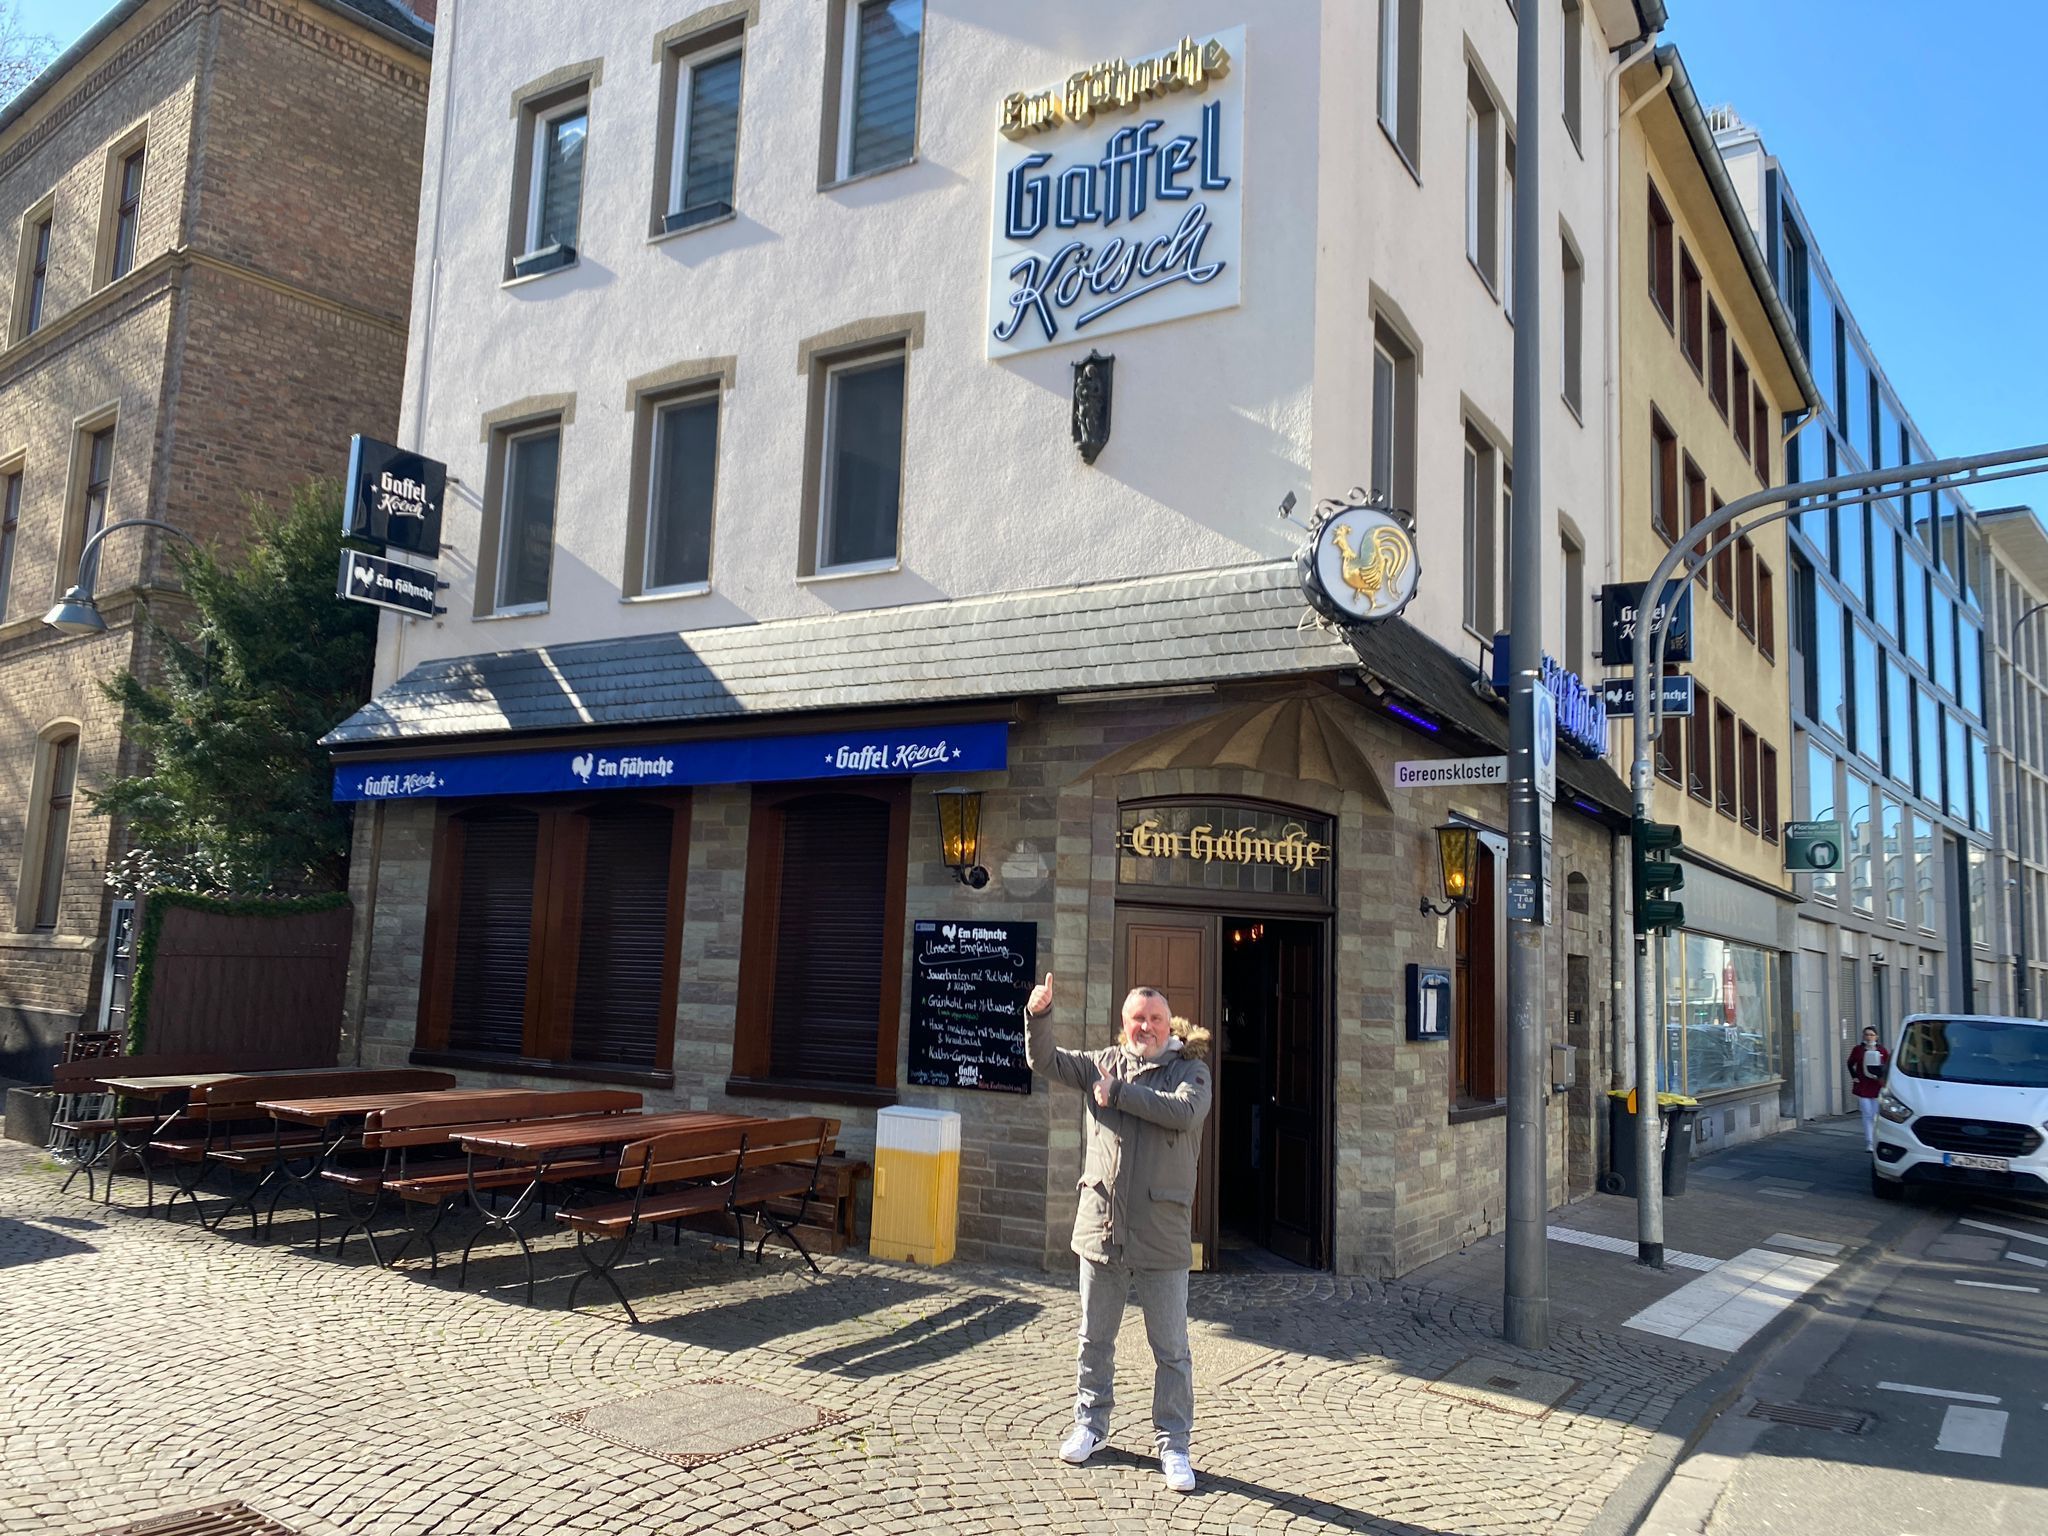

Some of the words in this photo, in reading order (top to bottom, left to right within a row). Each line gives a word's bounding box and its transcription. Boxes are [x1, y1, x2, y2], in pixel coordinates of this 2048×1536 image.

[1005, 100, 1231, 239] Gaffel
[993, 203, 1226, 342] Kölsch
[381, 472, 426, 503] Gaffel
[377, 493, 425, 520] Kölsch
[376, 574, 393, 589] Em
[395, 577, 433, 601] Hähnche
[597, 758, 617, 777] Em
[619, 756, 674, 778] Hähnche
[836, 745, 889, 770] Gaffel
[892, 740, 950, 769] Kölsch
[364, 774, 399, 796] Gaffel
[1400, 763, 1502, 783] Gereonskloster
[1132, 817, 1180, 859] Em
[1190, 823, 1321, 872] Hähnche
[925, 940, 958, 956] Unsere
[958, 928, 971, 939] Em
[972, 928, 1007, 941] Hähnche
